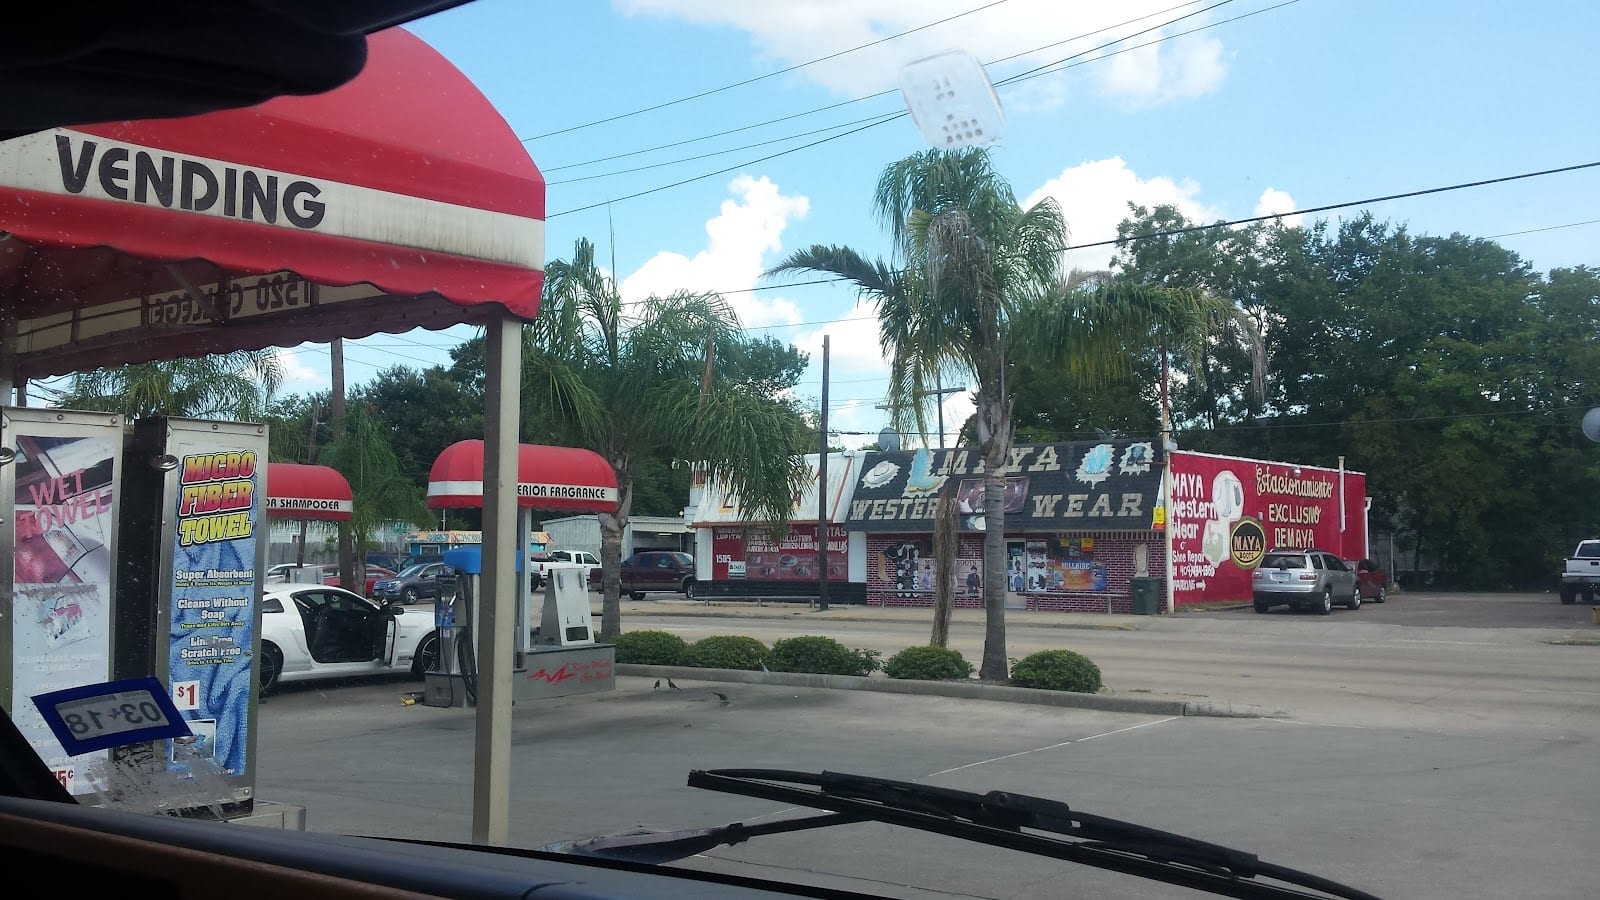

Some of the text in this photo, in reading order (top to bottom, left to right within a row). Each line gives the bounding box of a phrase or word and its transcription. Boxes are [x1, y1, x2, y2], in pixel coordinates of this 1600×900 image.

[55, 134, 326, 230] VENDING
[182, 450, 257, 484] MICRO
[28, 467, 86, 508] WET
[1171, 472, 1204, 498] MAYA
[1255, 463, 1335, 498] Estacionamiento
[179, 480, 254, 517] FIBER
[550, 486, 605, 499] FRAGRANCE
[19, 489, 110, 539] TOWEL
[279, 498, 339, 510] SHAMPOOER
[1032, 493, 1143, 518] WEAR
[1172, 499, 1217, 520] Western
[178, 512, 253, 546] TOWEL
[1172, 518, 1199, 541] Wear
[1233, 535, 1261, 551] MAYA
[1239, 552, 1254, 560] BOOTS
[176, 569, 253, 581] Super Absorbent
[177, 597, 249, 609] Cleans Without
[201, 609, 225, 621] Soap
[189, 635, 208, 647] Lin
[181, 647, 217, 659] Scratch
[177, 684, 196, 706] $1
